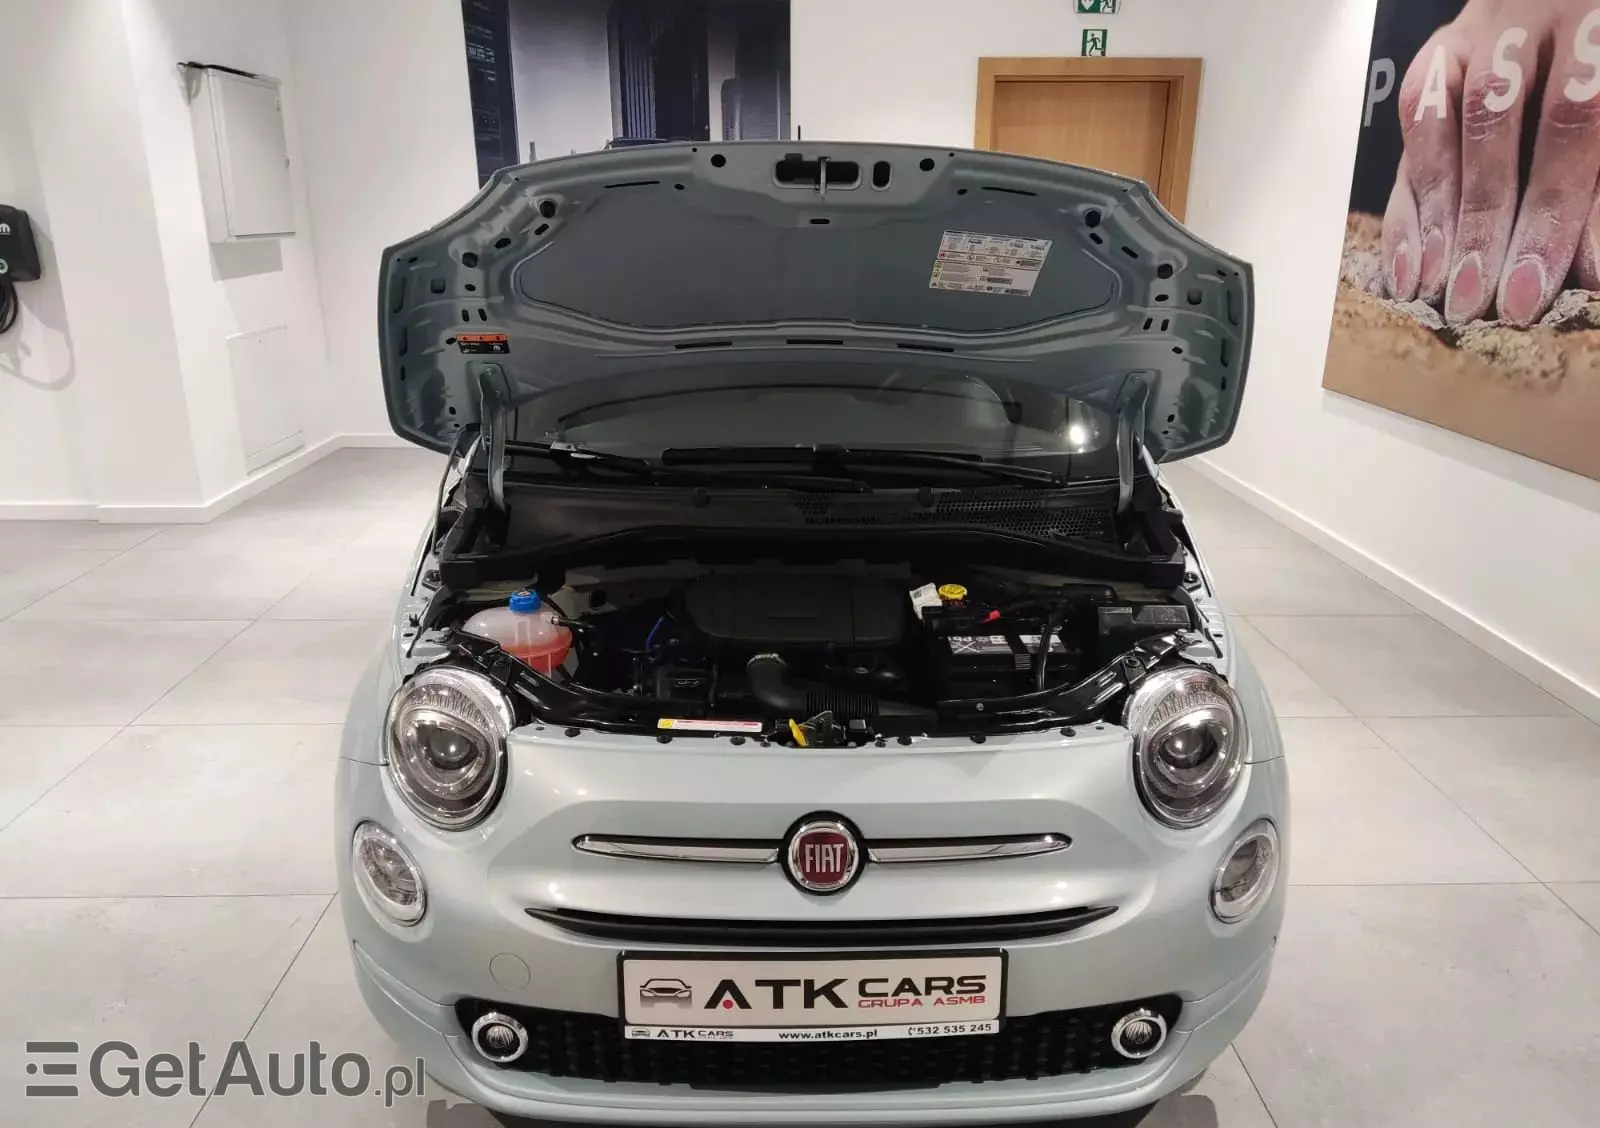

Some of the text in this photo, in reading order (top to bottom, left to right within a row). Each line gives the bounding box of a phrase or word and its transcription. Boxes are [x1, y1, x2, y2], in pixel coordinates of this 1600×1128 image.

[804, 843, 845, 873] FIAT
[703, 975, 986, 1010] ATK CARS
[858, 995, 986, 1008] GRUPA ASMB
[657, 1029, 696, 1039] ATK
[778, 1028, 878, 1040] www.atkcars.pl
[917, 1023, 992, 1035] 532 535 245
